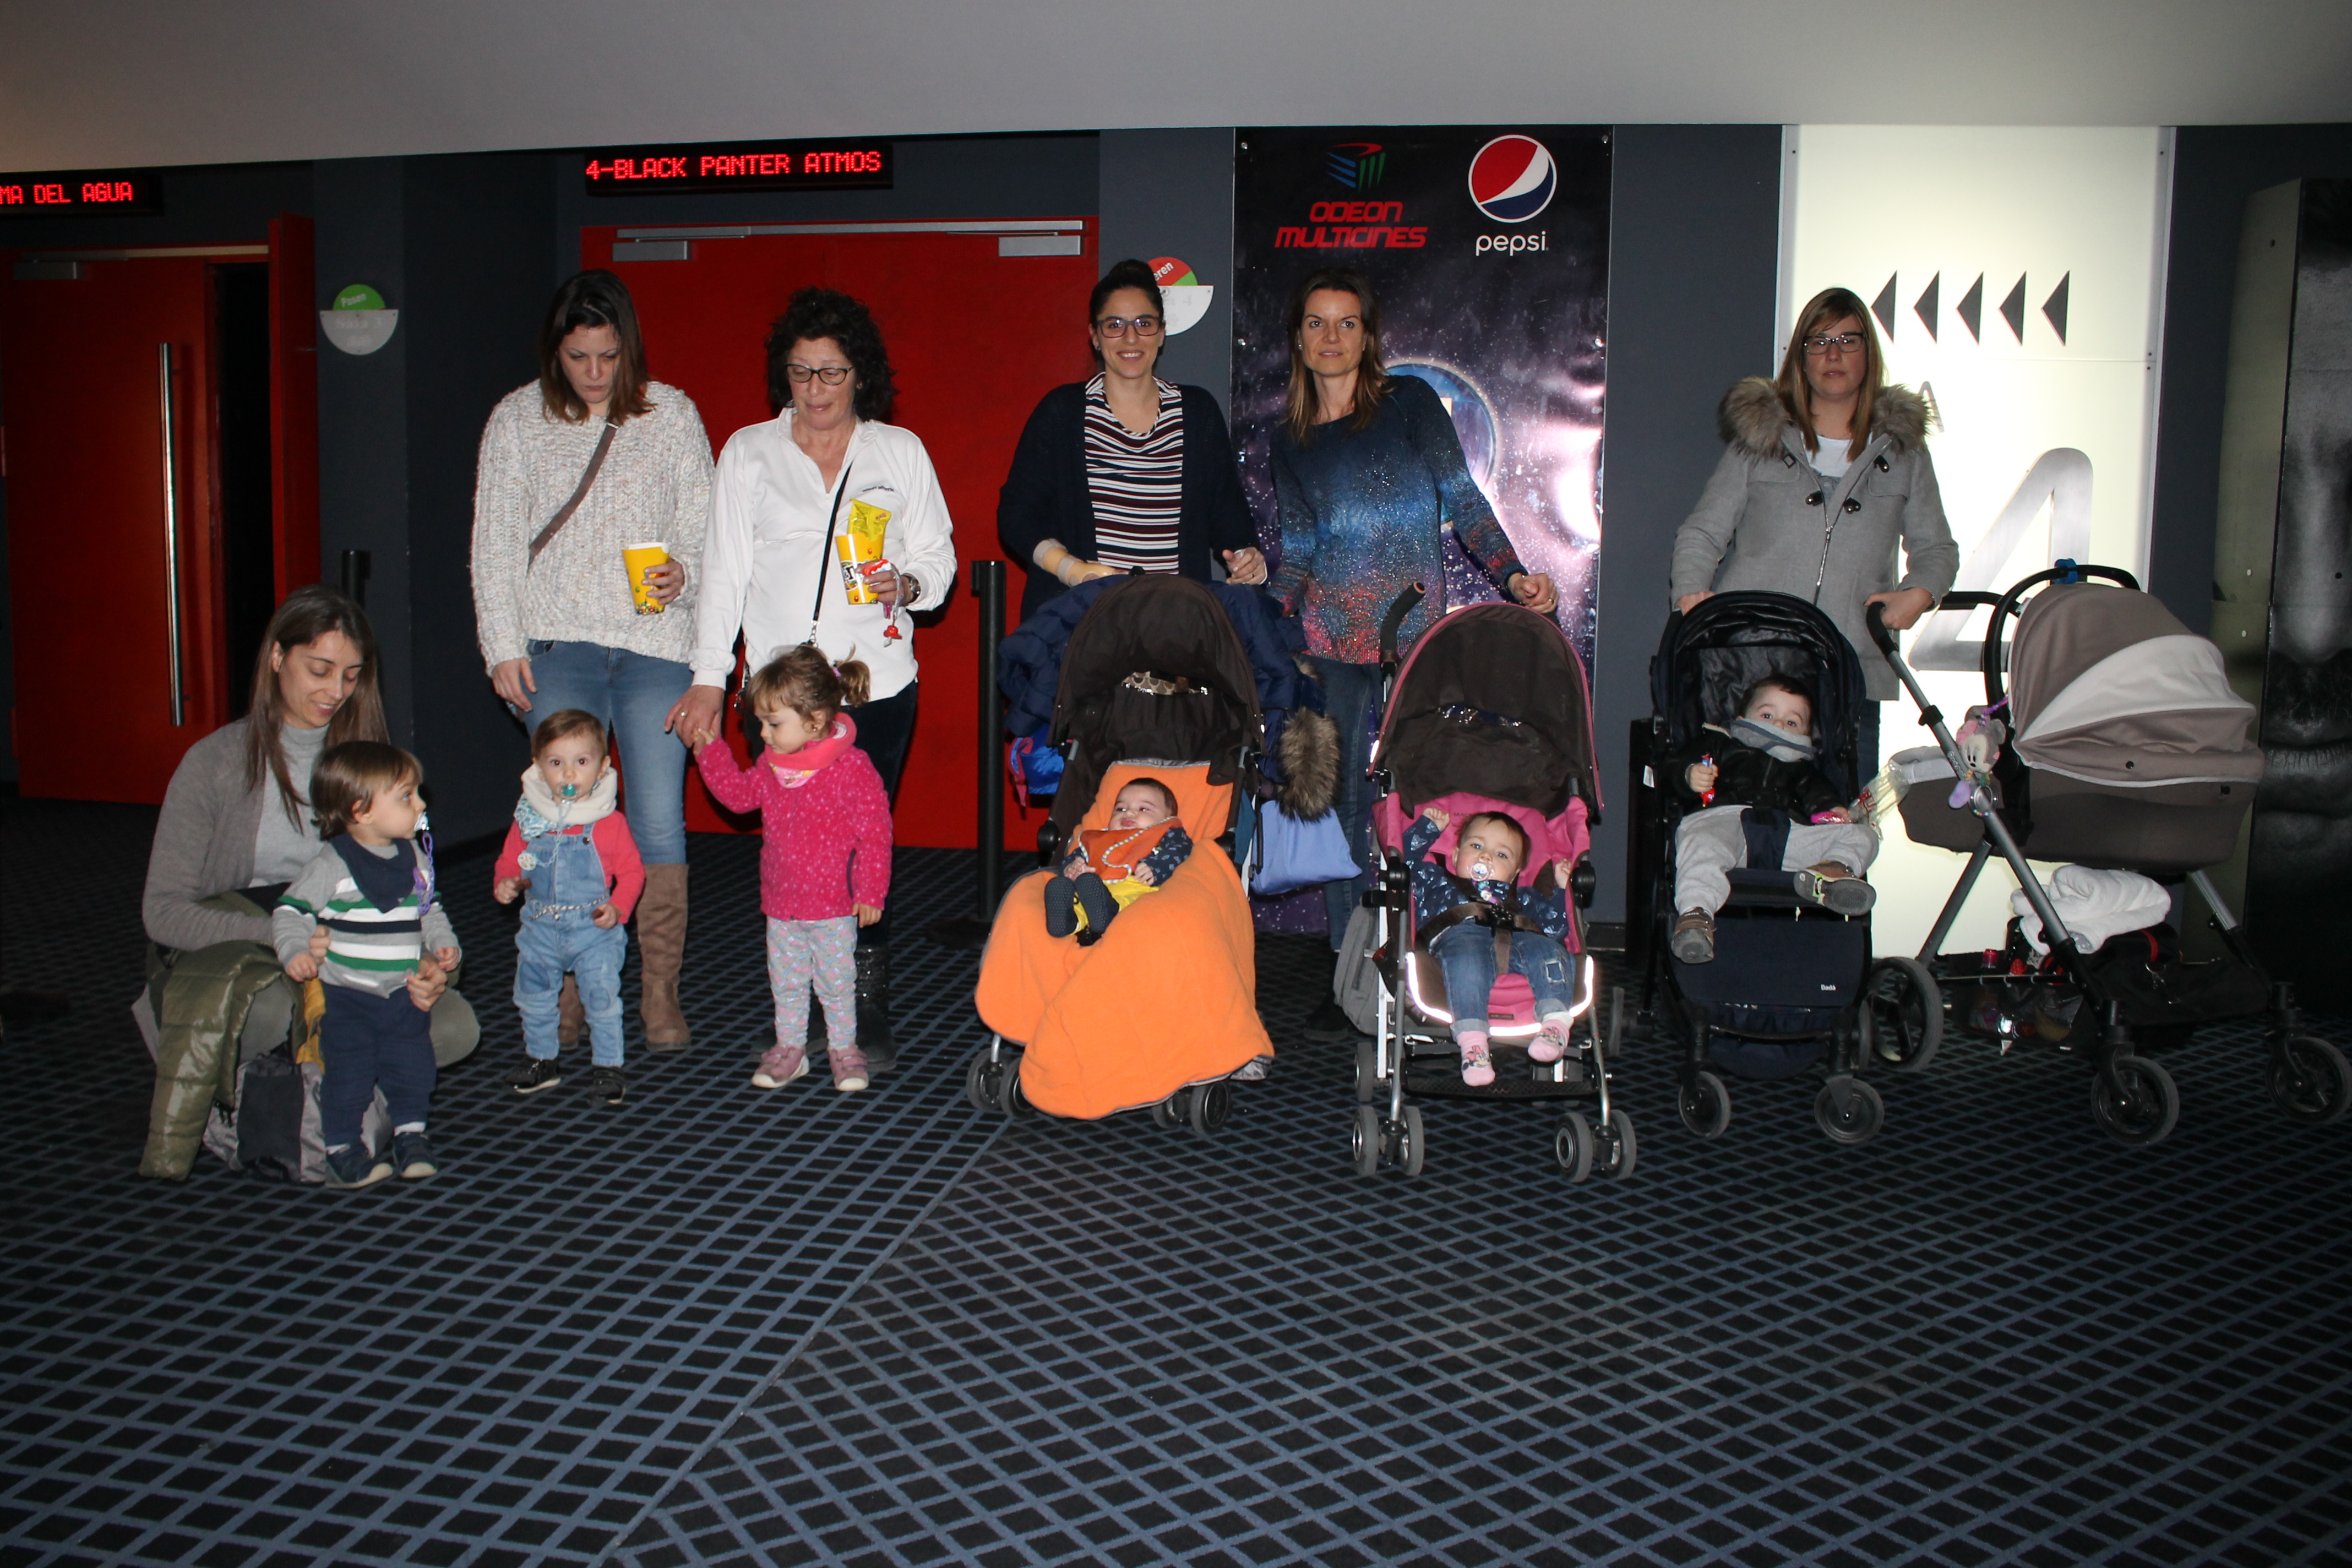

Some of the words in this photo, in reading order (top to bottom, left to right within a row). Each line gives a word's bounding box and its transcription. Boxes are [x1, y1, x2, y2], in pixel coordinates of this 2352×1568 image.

[586, 156, 688, 180] 4-BLACK
[700, 154, 791, 176] PANTER
[804, 151, 881, 173] ATMOS
[34, 184, 72, 204] DEL
[82, 182, 133, 202] AGUA
[1309, 202, 1403, 222] ODEON
[1274, 227, 1428, 248] MULTICINES
[1476, 231, 1546, 257] pepsi
